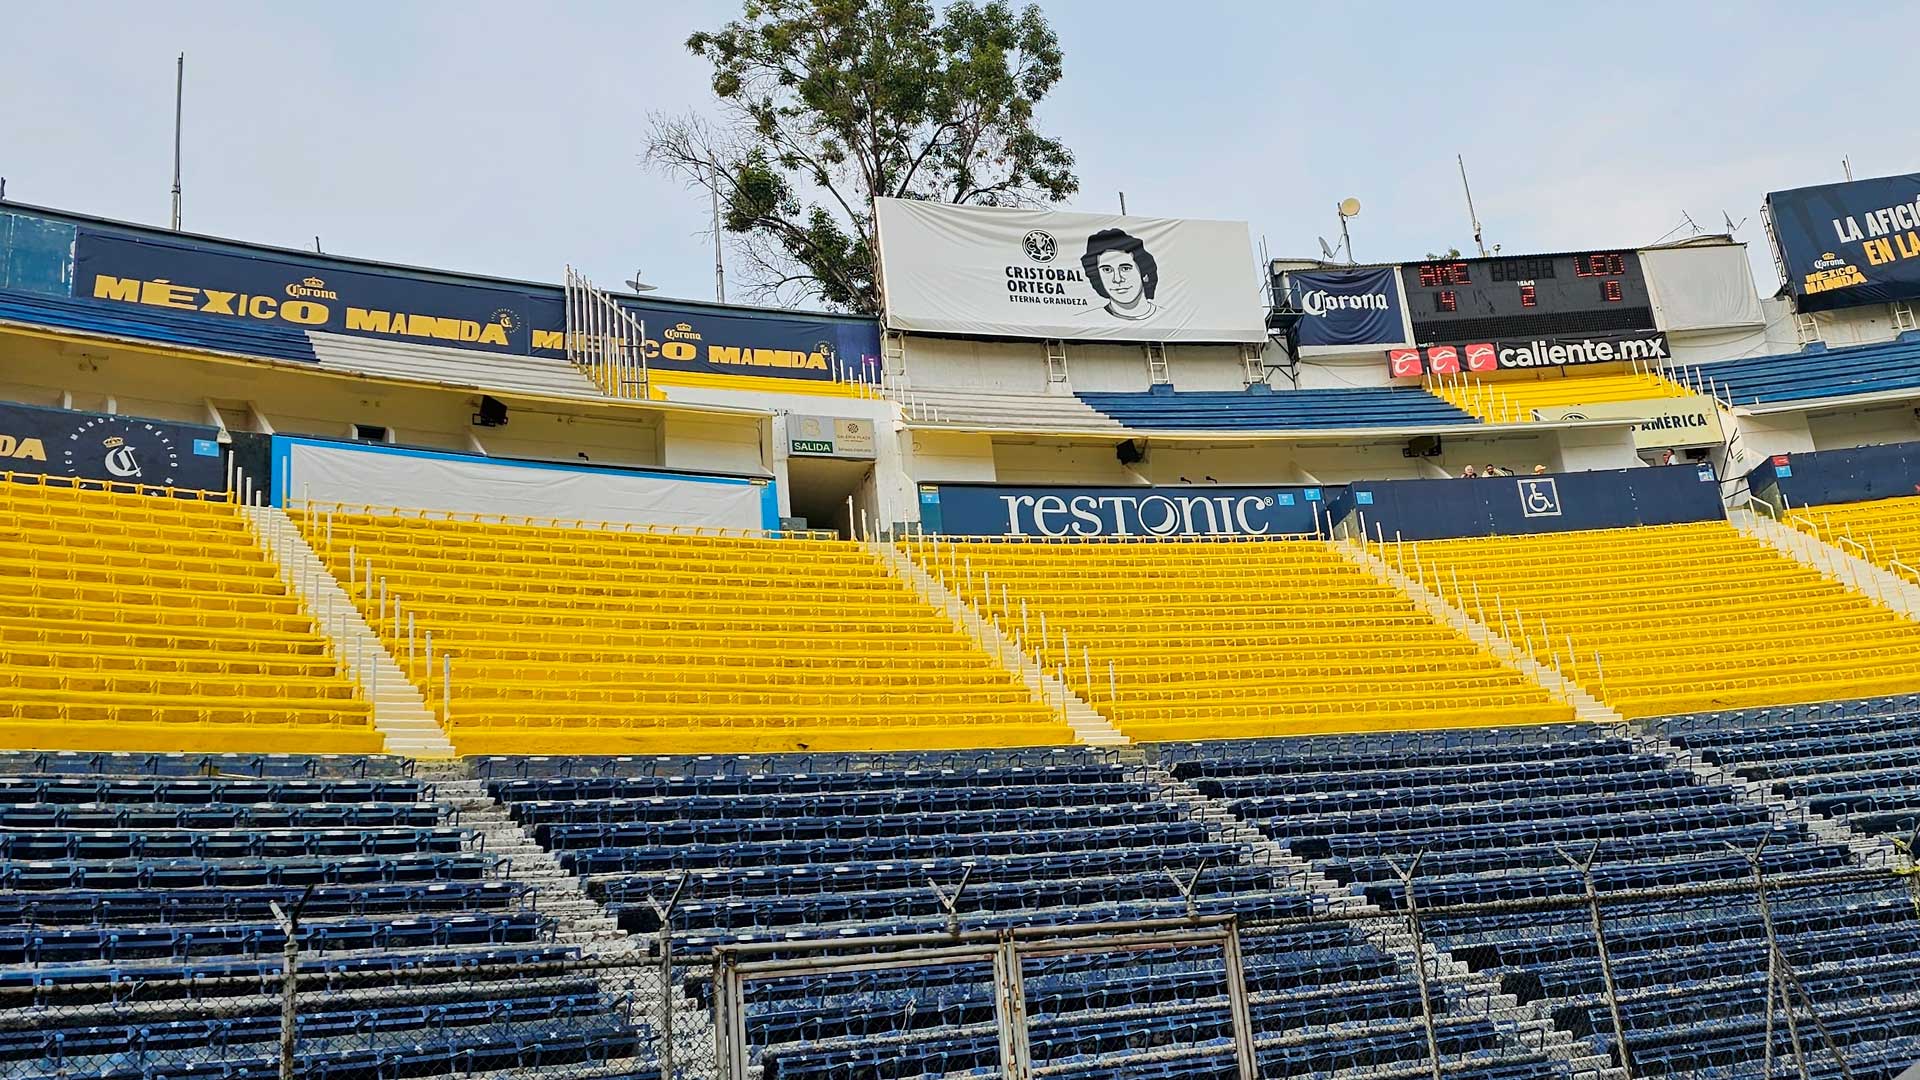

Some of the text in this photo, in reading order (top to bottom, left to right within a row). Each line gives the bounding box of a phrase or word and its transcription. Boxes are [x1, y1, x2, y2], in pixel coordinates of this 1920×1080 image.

[1833, 216, 1864, 243] LA
[1863, 237, 1896, 266] EN
[1005, 265, 1084, 282] CRISTÓBAL
[1814, 258, 1846, 269] Corona
[1804, 272, 1868, 295] MANDA
[1805, 265, 1858, 283] MÉXICO
[285, 283, 337, 299] Corona
[1007, 279, 1065, 295] ORTEGA
[1521, 286, 1536, 307] 2
[93, 274, 329, 325] MÉXICO
[345, 307, 509, 346] MANDA
[1009, 294, 1088, 306] ETERNA GRANDEZA
[1302, 289, 1389, 317] Corona
[1441, 290, 1456, 311] 4
[664, 329, 702, 341] Corona
[708, 345, 829, 370] MANDA
[1499, 338, 1667, 368] caliente.mx
[1641, 412, 1708, 431] AMÉRICA
[794, 442, 831, 452] SALIDA
